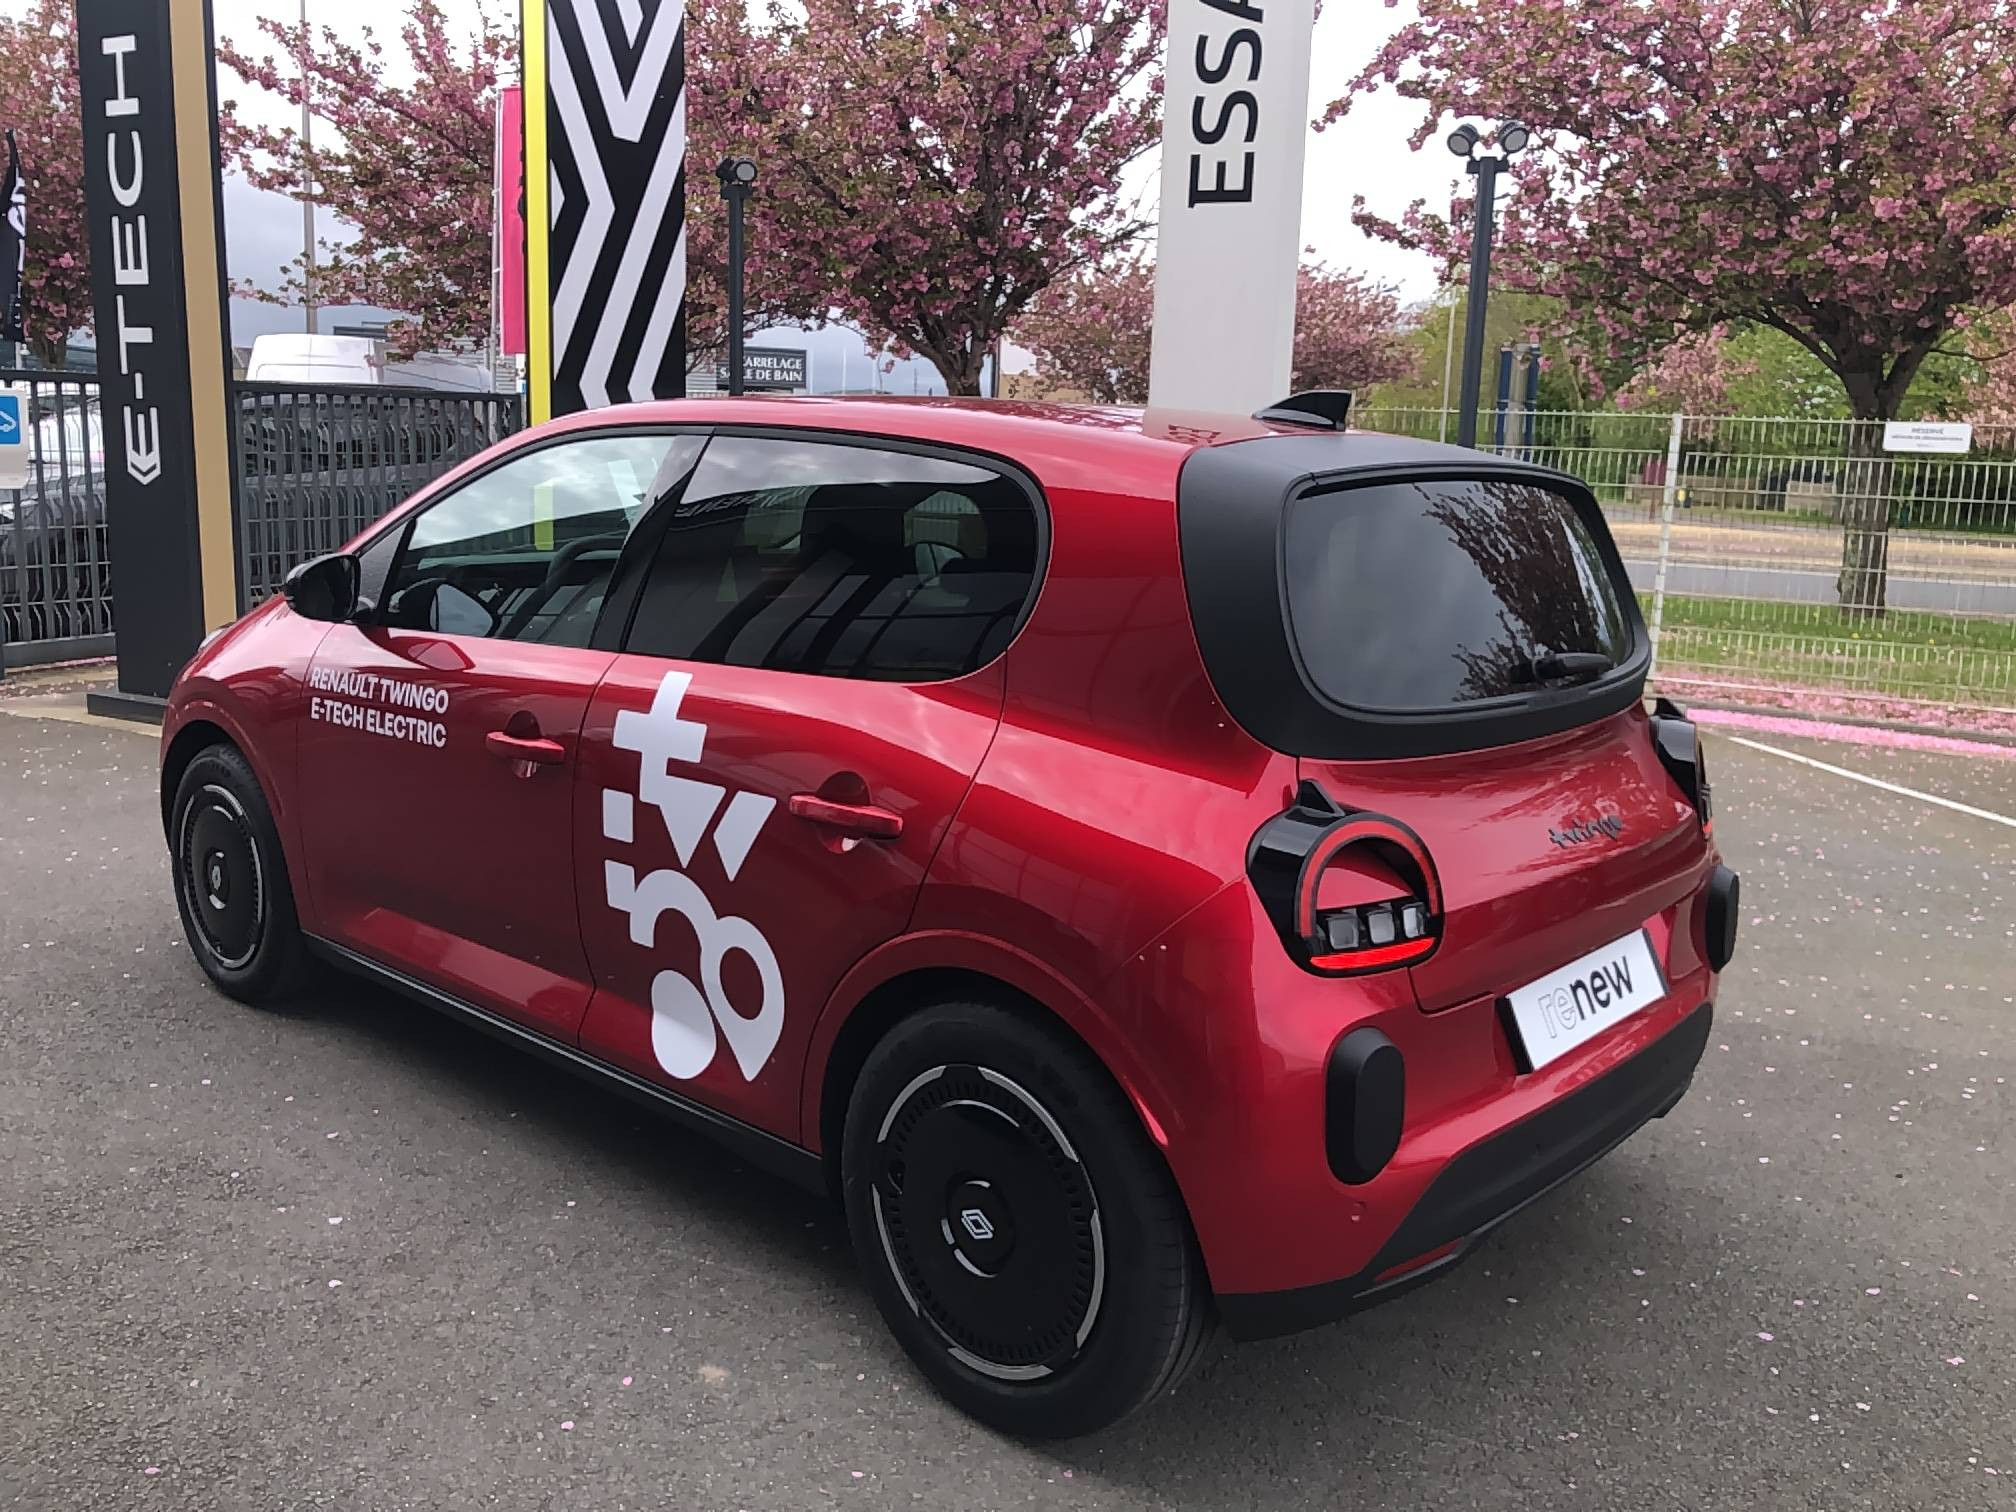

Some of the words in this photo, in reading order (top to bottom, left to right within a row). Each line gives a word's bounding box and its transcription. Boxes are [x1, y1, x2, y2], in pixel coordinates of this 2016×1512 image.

[101, 34, 161, 485] E-TECH
[743, 356, 802, 369] ARRELAGE
[755, 369, 772, 381] DE
[773, 370, 802, 382] BAIN
[309, 666, 379, 699] RENAULT
[380, 677, 449, 714] TWINGO
[310, 696, 364, 730] E-TECH
[366, 708, 447, 748] ELECTRIC
[1538, 955, 1633, 1039] renew
